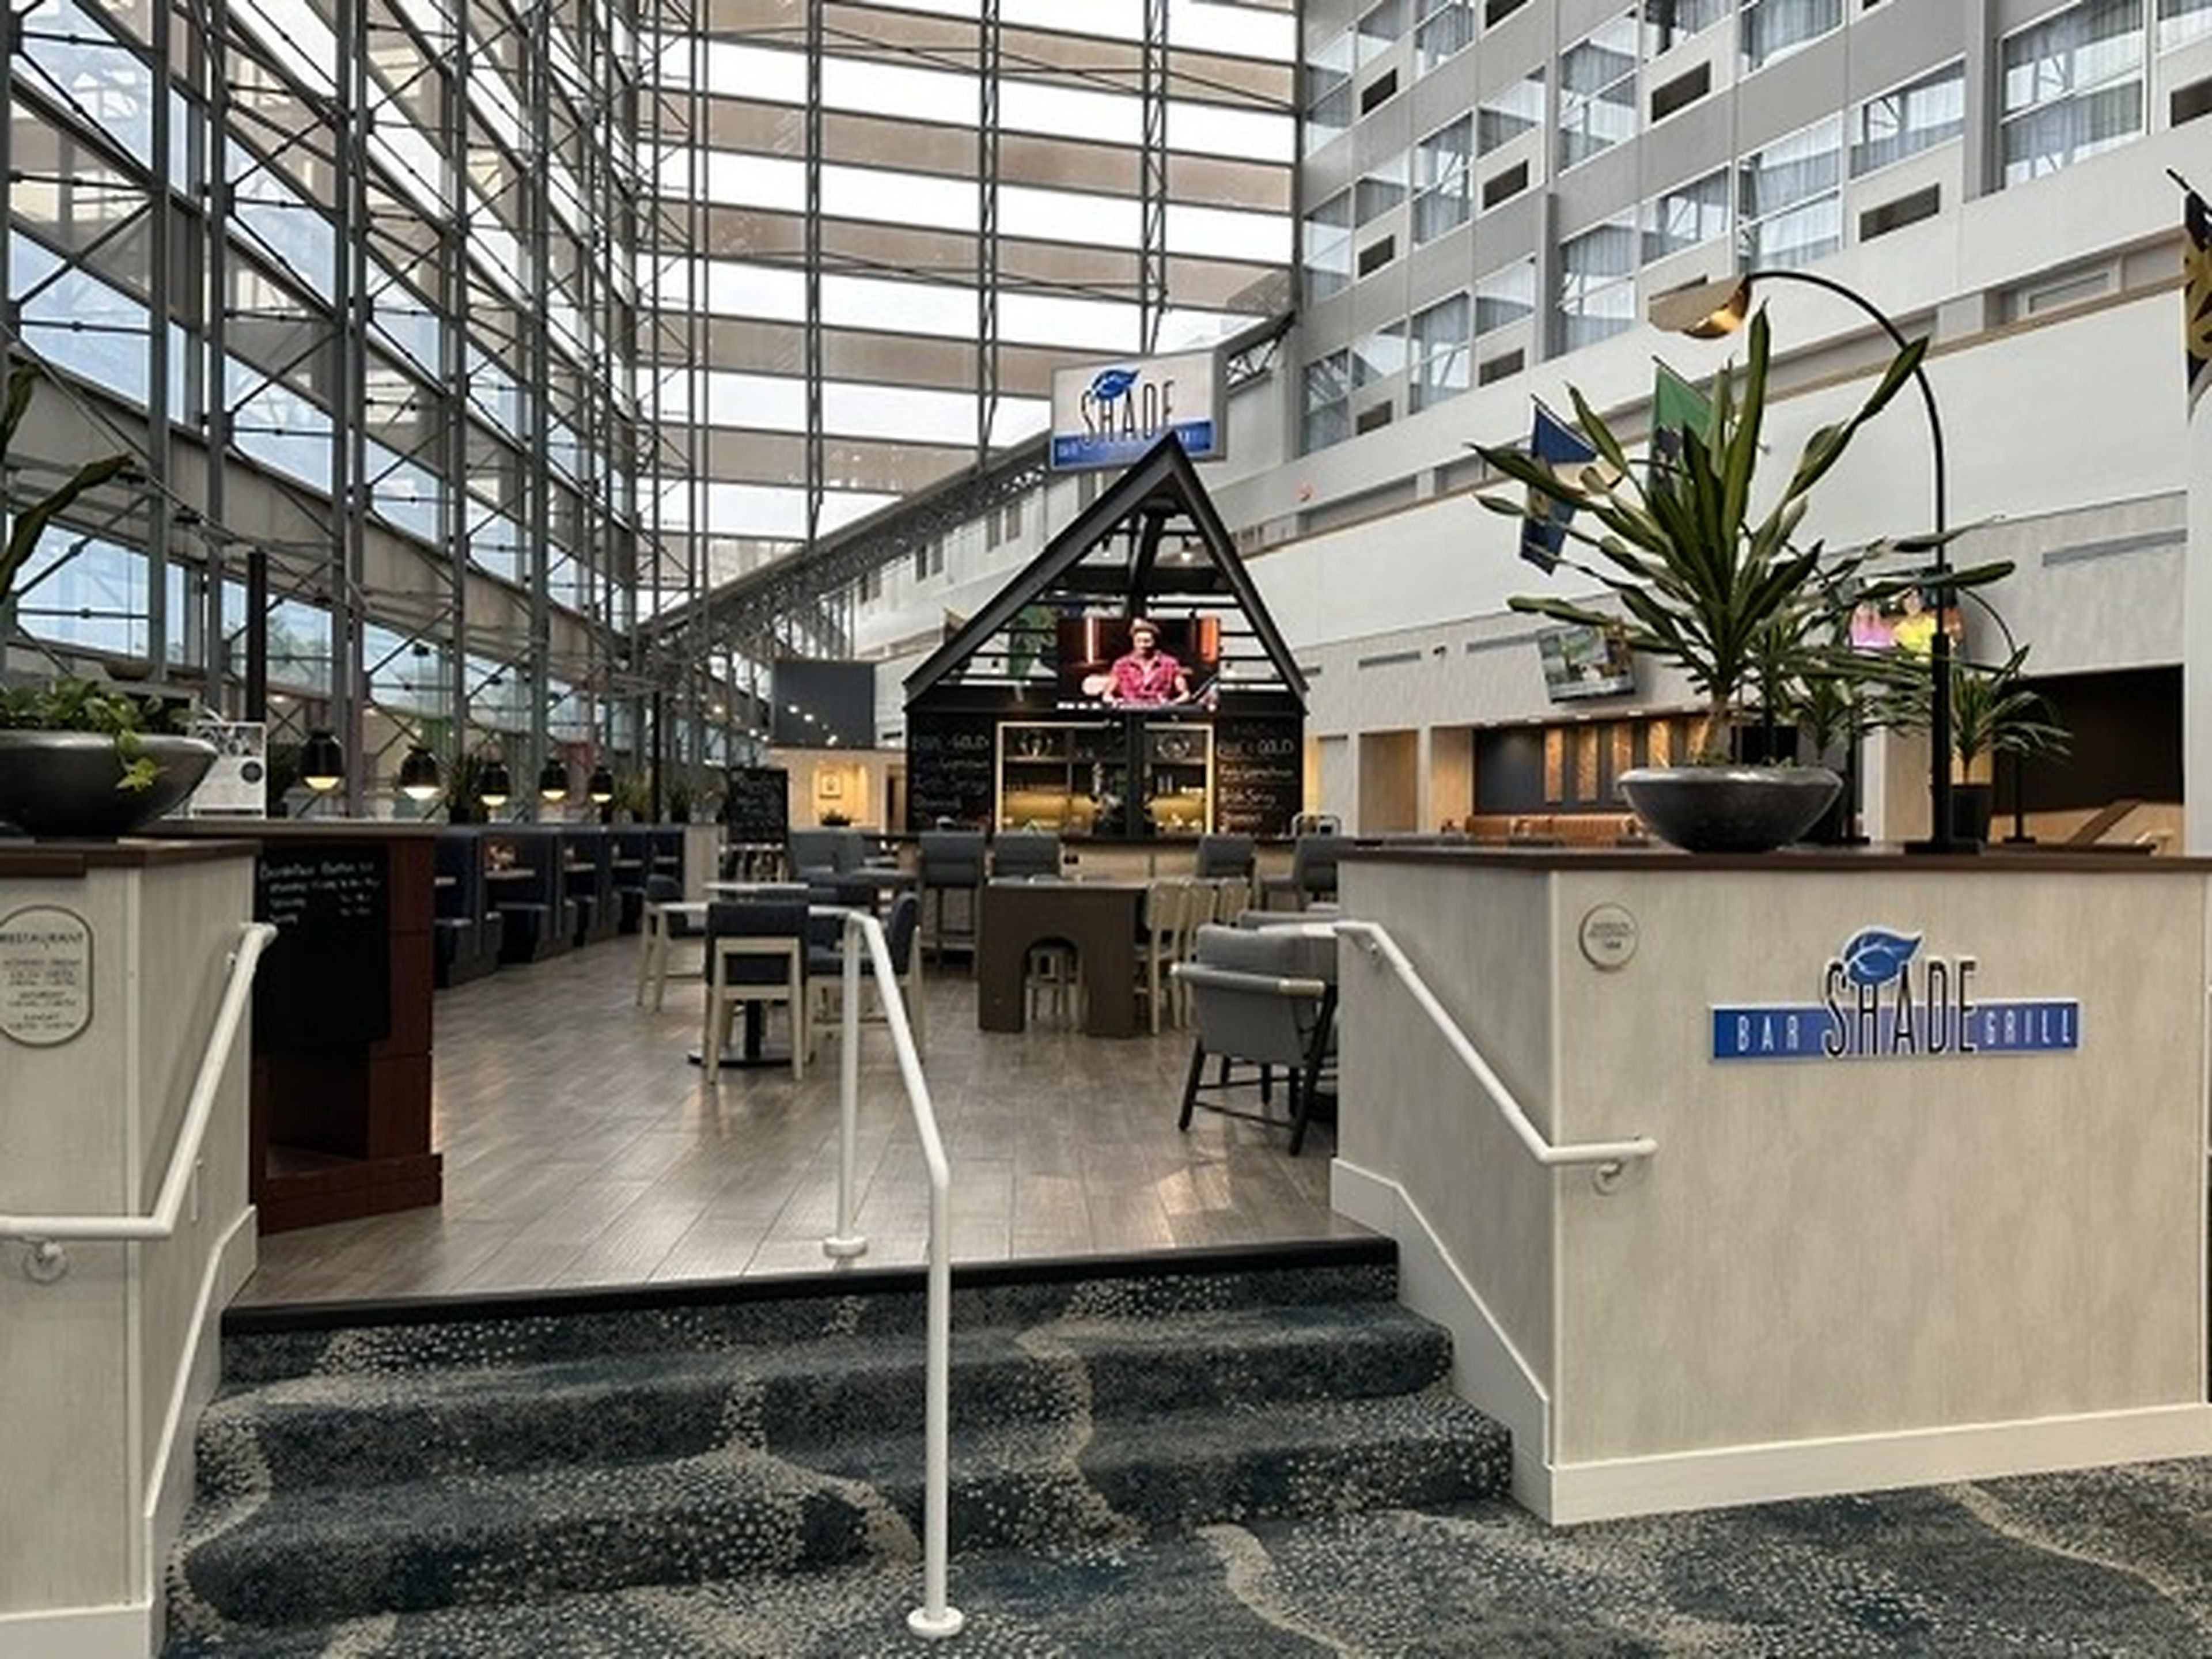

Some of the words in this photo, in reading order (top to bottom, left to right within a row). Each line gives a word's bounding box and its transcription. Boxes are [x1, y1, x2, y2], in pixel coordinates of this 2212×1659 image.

[1081, 380, 1175, 447] SHADE
[1736, 1015, 1800, 1053] BAR
[1821, 959, 1978, 1056] SHADE
[1985, 1008, 2073, 1046] GRILL
